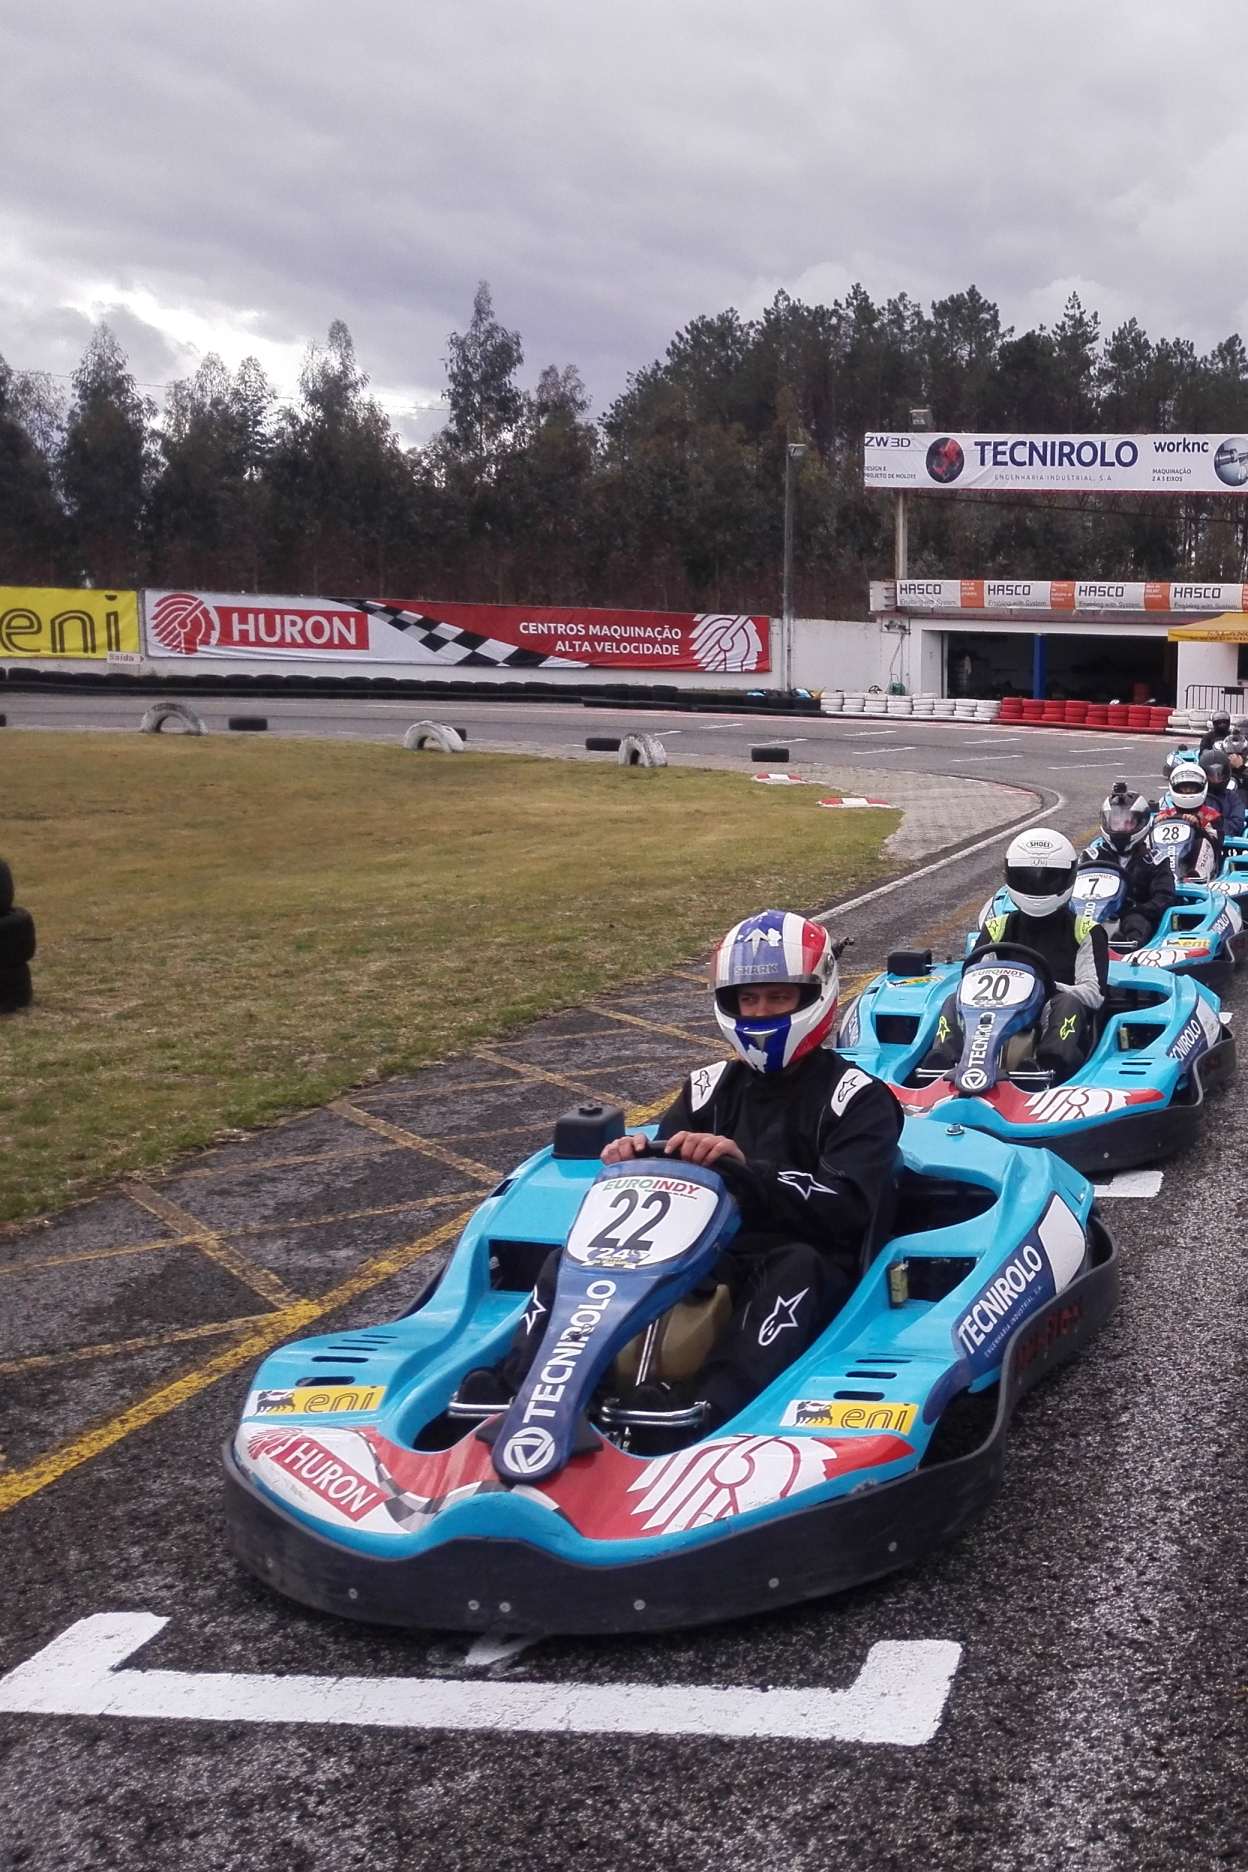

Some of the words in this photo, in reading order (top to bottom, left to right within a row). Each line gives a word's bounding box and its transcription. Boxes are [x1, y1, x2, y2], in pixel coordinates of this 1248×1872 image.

[864, 436, 911, 448] ZW3D
[1153, 436, 1209, 453] worknc
[974, 440, 1139, 468] TECNIROLO
[899, 583, 942, 595] HASCO
[988, 584, 1031, 596] HASCO
[1079, 585, 1124, 597] HASCO
[1173, 587, 1221, 599] HASCO
[0, 594, 120, 654] eni
[231, 612, 357, 645] HURON
[519, 621, 585, 636] CENTROS
[588, 623, 682, 642] MAQUINAÇÃO
[555, 639, 591, 653] ALTA
[594, 640, 680, 656] VELOCIDADE
[1161, 826, 1180, 841] 28
[1088, 878, 1100, 897] 7
[735, 962, 778, 977] SHARK
[972, 974, 1010, 1001] 20
[603, 1178, 702, 1196] EUROINDY
[587, 1188, 672, 1251] 22
[957, 1244, 1043, 1355] TECNIROLO
[523, 1279, 617, 1424] TECNIROLO
[303, 1385, 377, 1414] eni
[840, 1402, 910, 1432] eni
[283, 1442, 377, 1513] HURON
